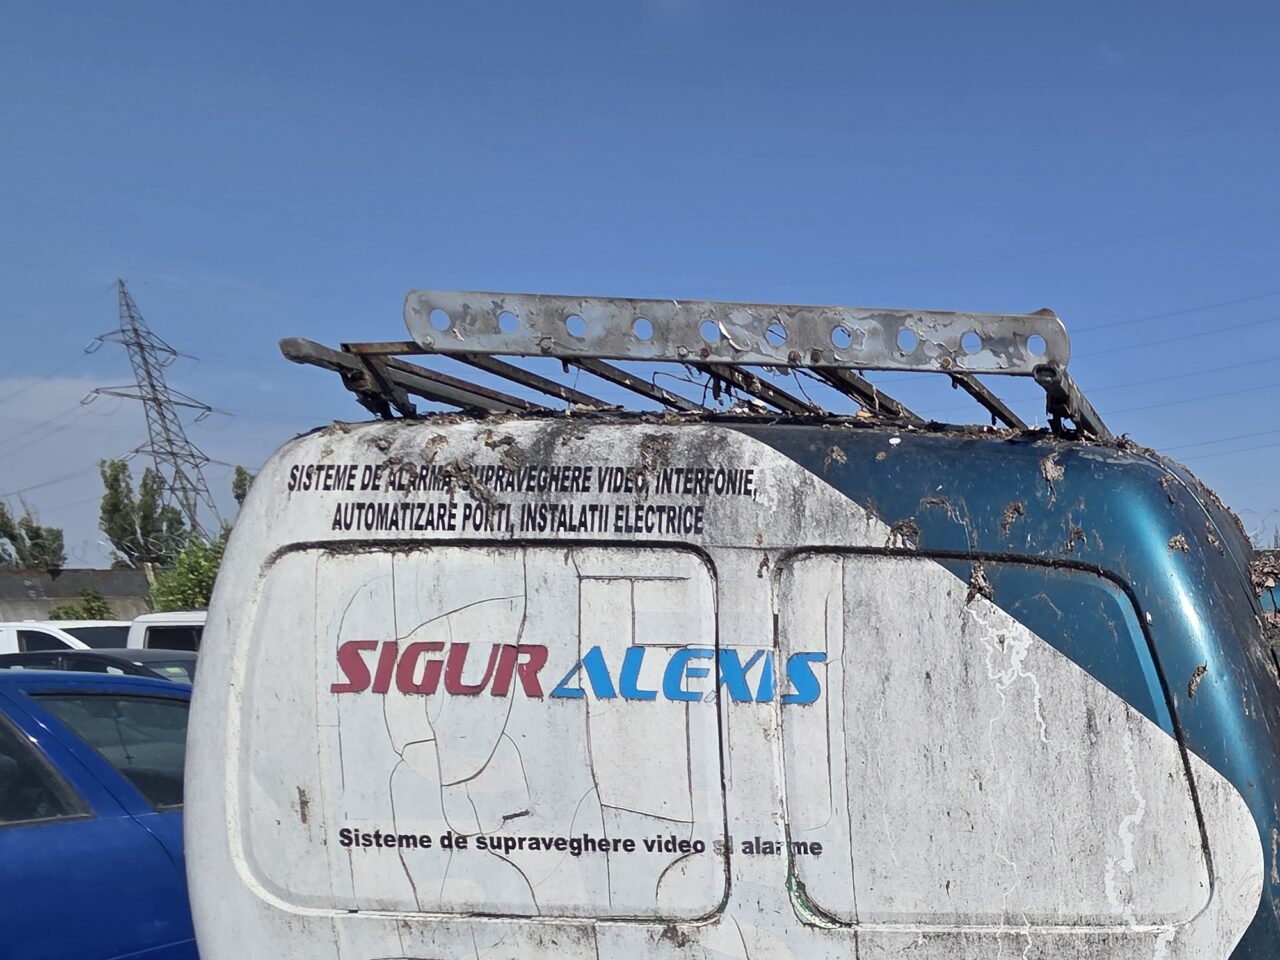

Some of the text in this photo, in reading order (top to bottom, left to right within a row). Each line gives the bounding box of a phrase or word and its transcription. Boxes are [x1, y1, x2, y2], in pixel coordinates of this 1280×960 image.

[288, 464, 358, 491] SISTEME
[360, 464, 382, 491] DE
[655, 467, 758, 501] INTERFONIE,
[332, 503, 457, 531] AUTOMATIZARE
[520, 503, 608, 532] INSTALATII
[613, 504, 704, 534] ELECTRICE
[339, 828, 432, 848] Sisteme
[440, 831, 468, 850] de
[475, 832, 636, 857] supraveghere
[643, 834, 705, 854] video
